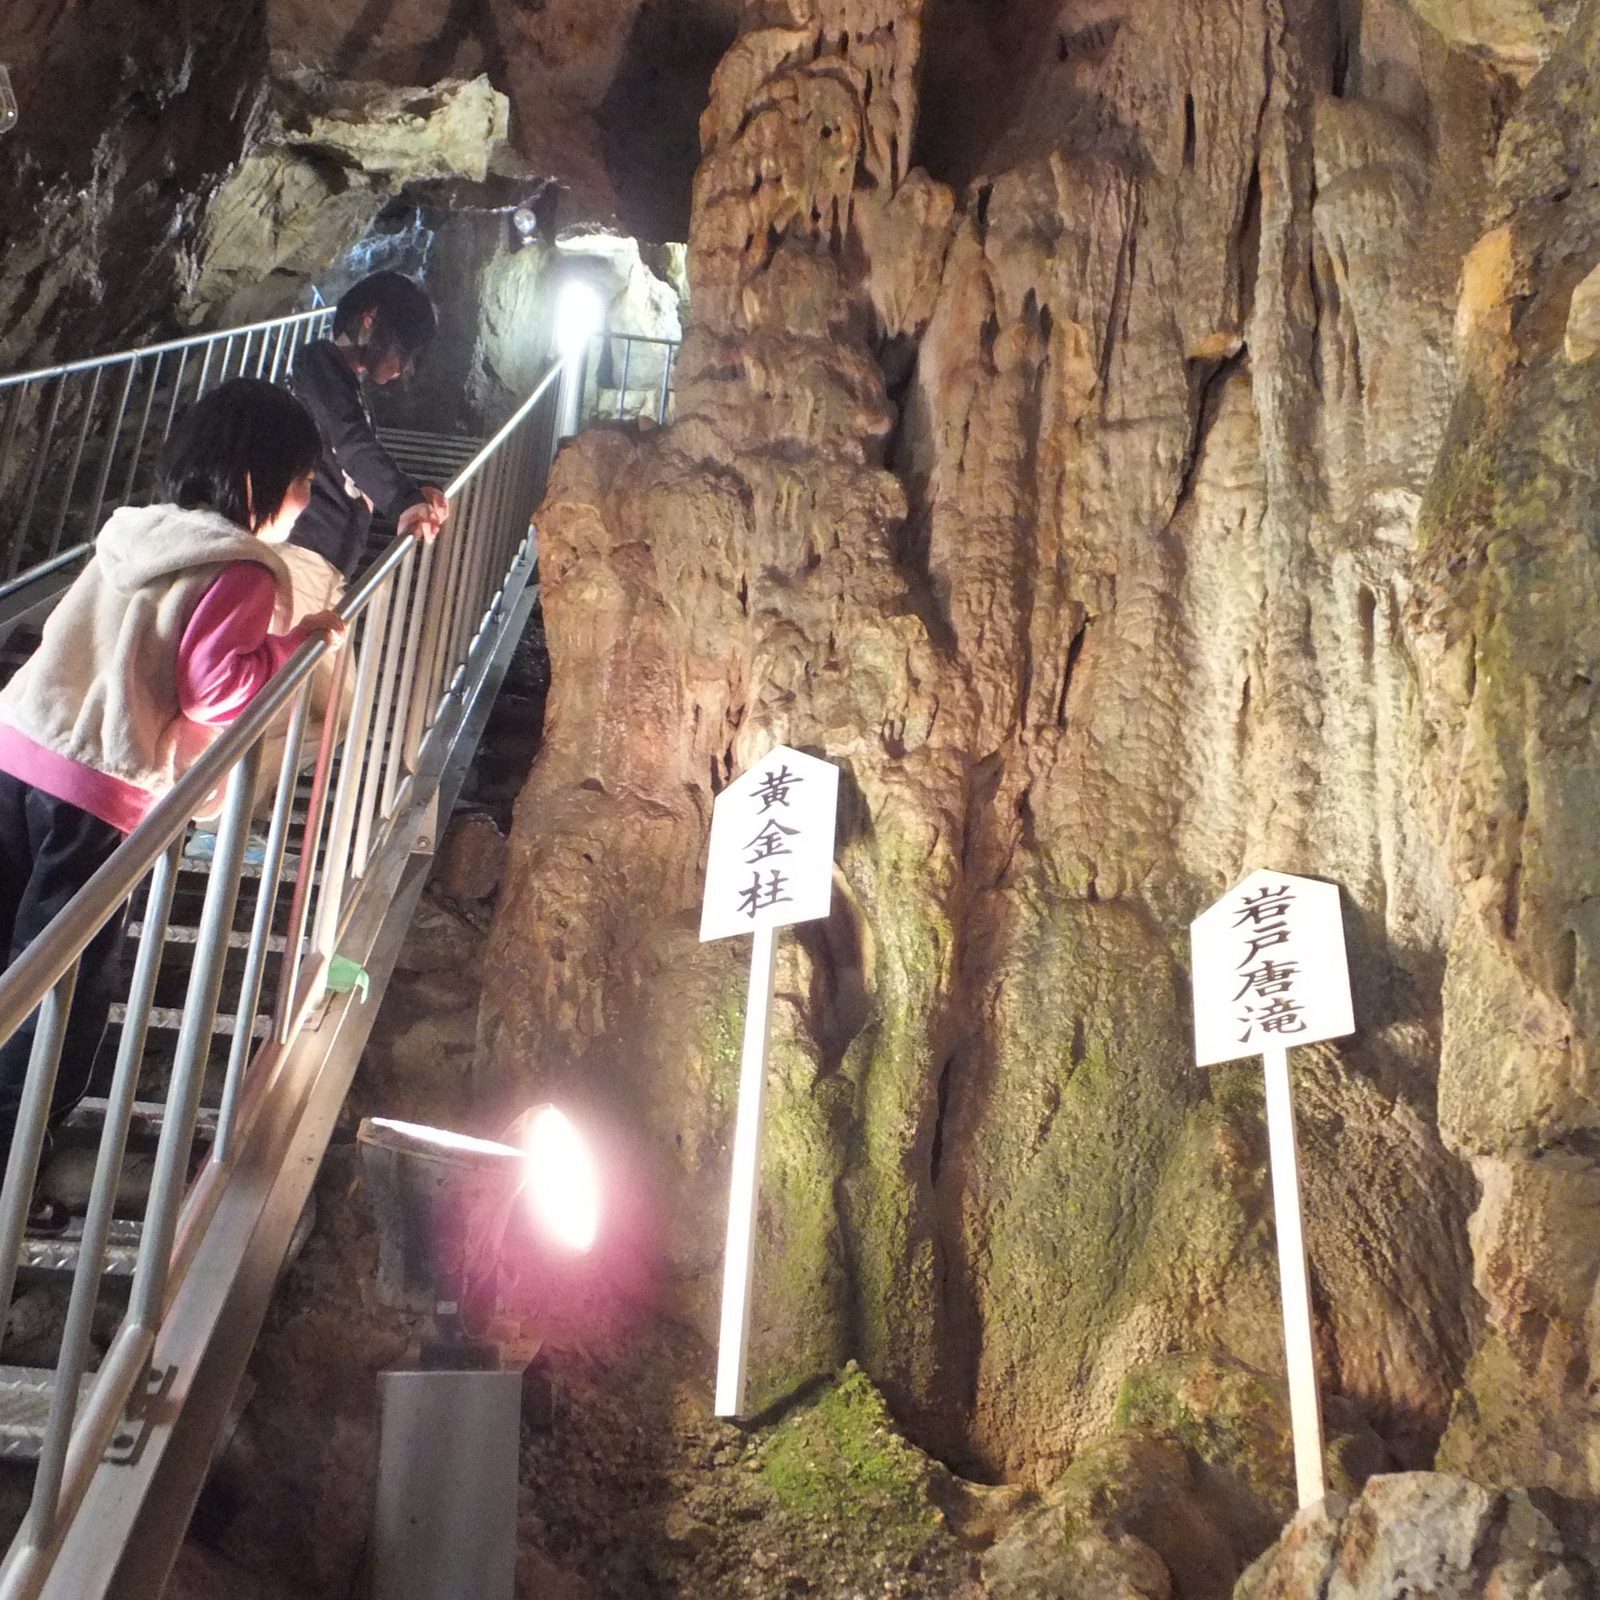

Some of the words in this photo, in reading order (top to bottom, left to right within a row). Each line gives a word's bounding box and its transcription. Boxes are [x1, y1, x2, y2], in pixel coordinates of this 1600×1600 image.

[736, 764, 804, 919] 黄金柱
[1231, 885, 1307, 1043] 岩戸唐滝
